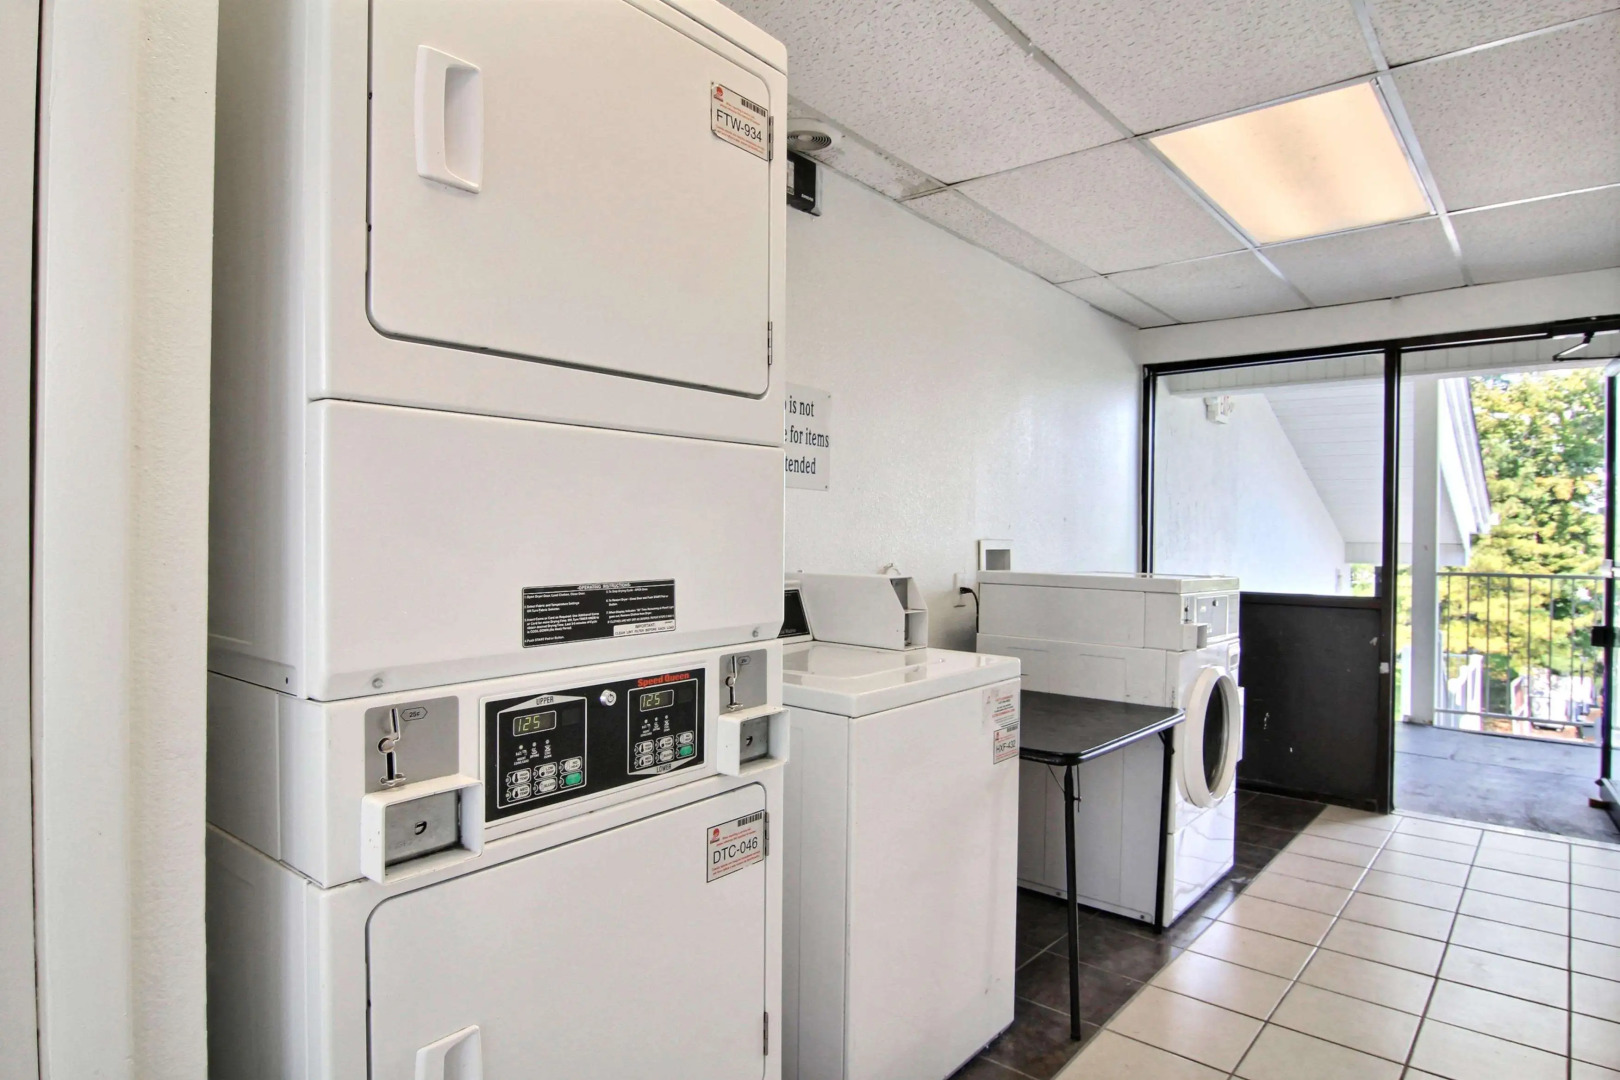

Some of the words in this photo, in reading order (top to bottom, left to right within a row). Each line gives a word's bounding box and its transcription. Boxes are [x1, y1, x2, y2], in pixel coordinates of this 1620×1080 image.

[716, 108, 762, 142] FTW-934
[790, 395, 797, 414] is
[800, 400, 814, 417] not
[790, 424, 803, 444] for
[805, 428, 830, 448] items
[638, 676, 663, 688] Speed
[665, 673, 690, 682] Queen
[536, 696, 554, 705] UPPER
[656, 763, 672, 773] LOWER
[713, 837, 758, 864] DTC-046
